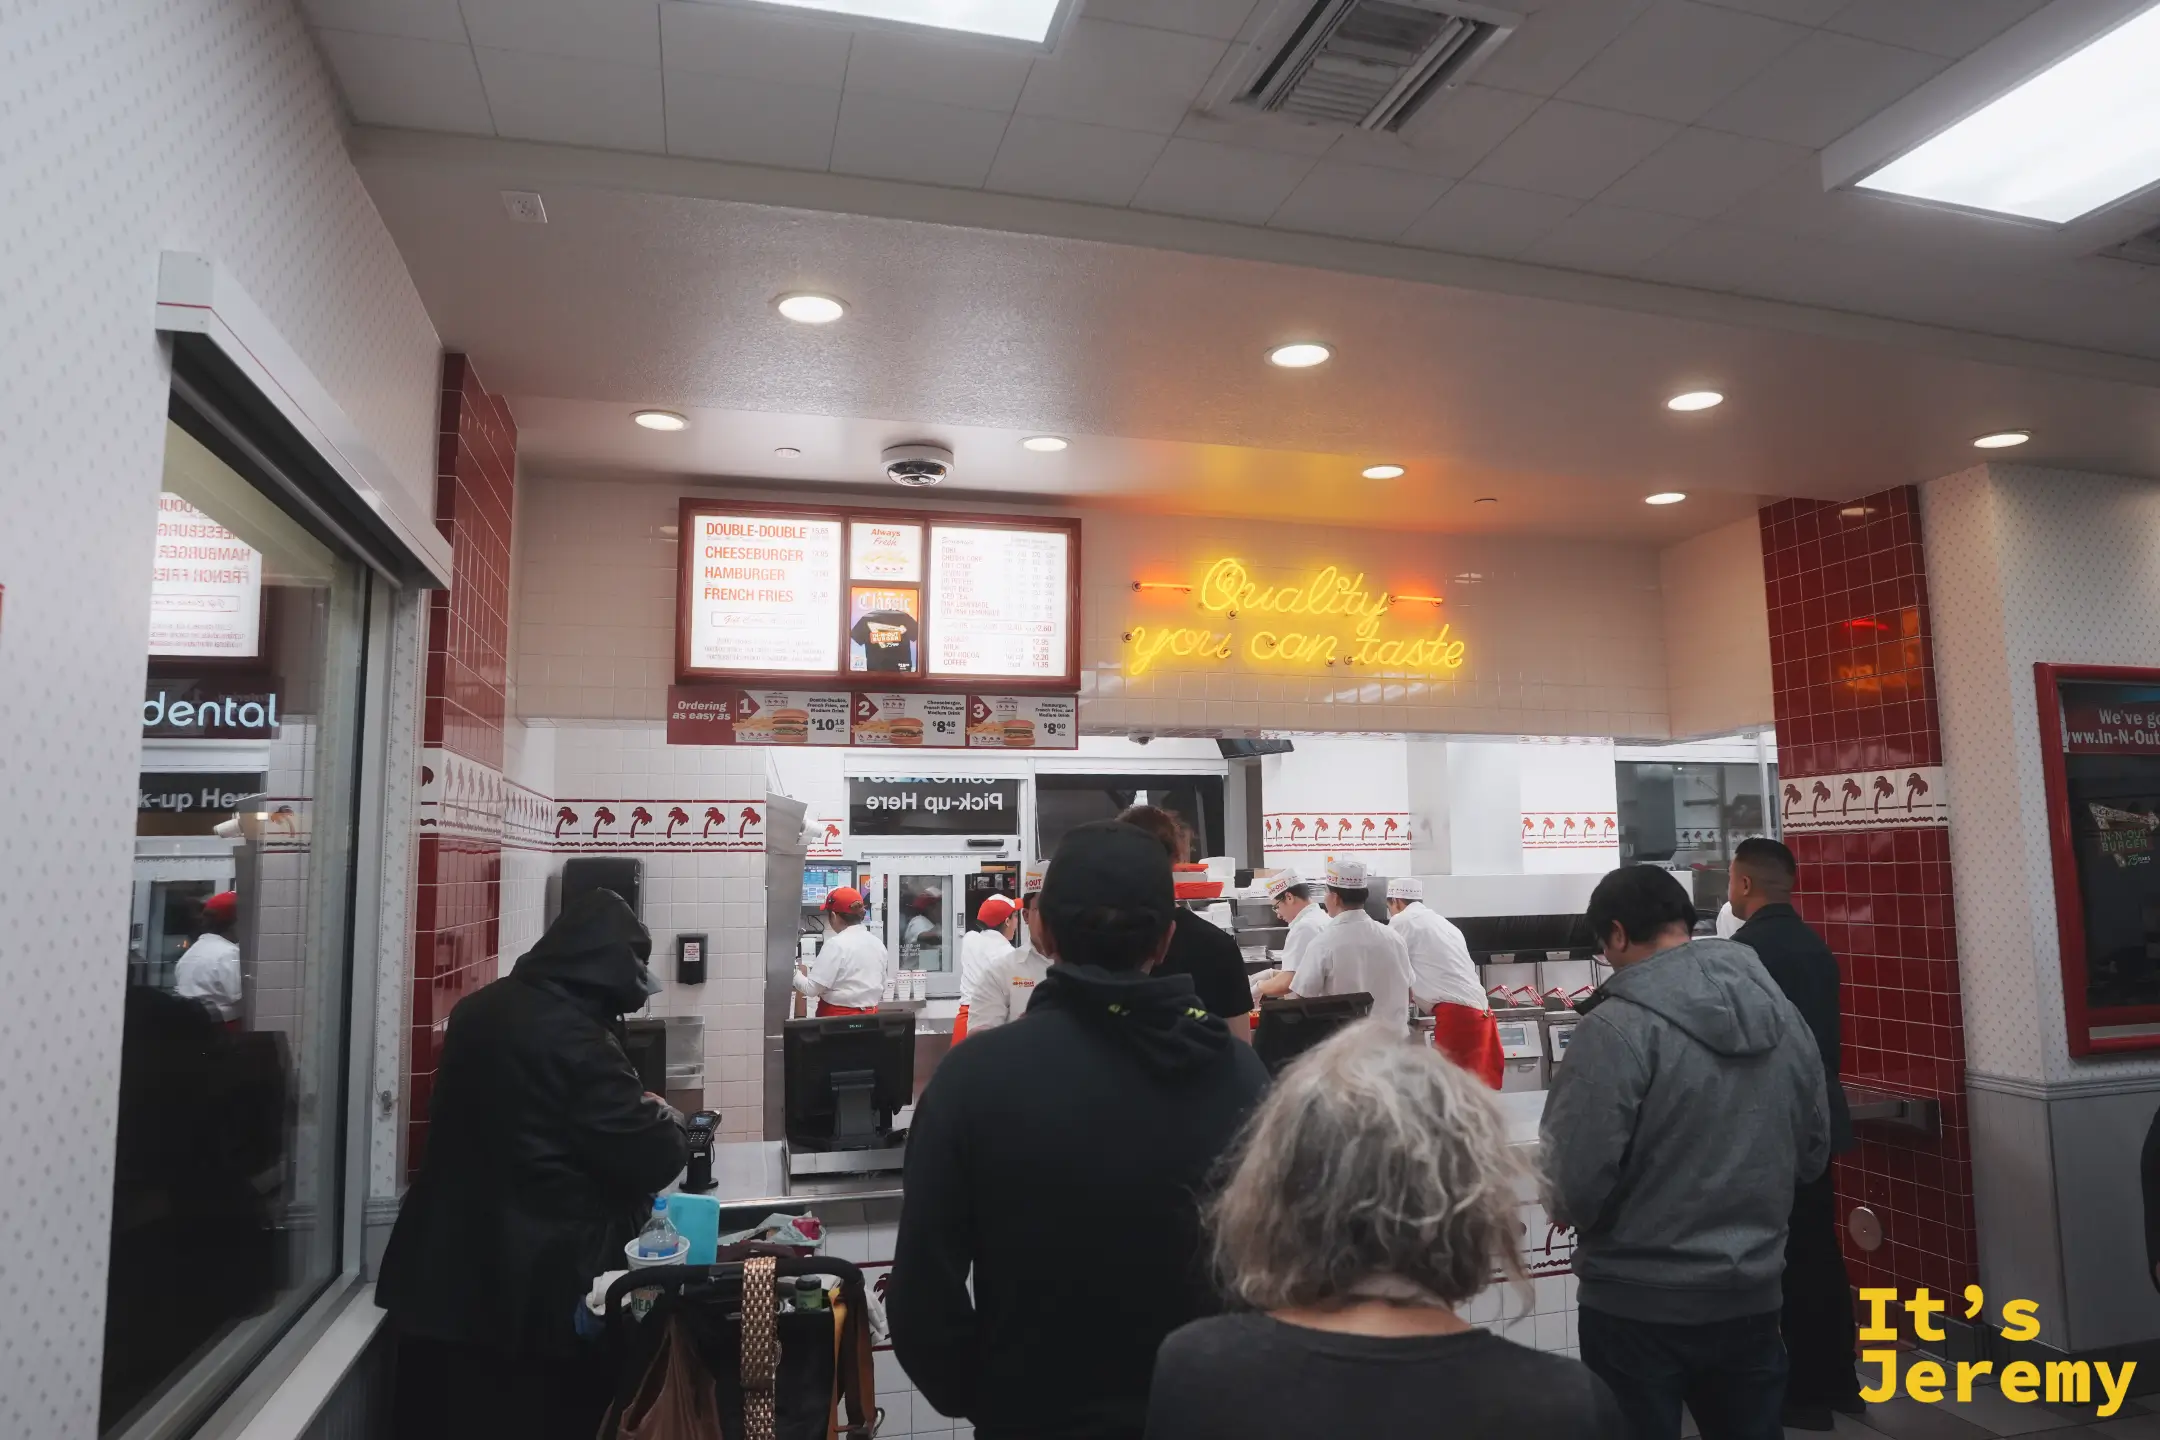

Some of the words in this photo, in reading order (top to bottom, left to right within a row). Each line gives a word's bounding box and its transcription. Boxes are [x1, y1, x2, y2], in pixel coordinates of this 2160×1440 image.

[705, 522, 807, 539] DOUBLE-DOUBLE
[871, 528, 901, 538] Always
[704, 545, 804, 562] CHEESEBURGER
[704, 566, 786, 581] HAMBURGER
[703, 587, 755, 601] FRENCH
[758, 589, 794, 603] FRIES
[858, 592, 912, 611] Classic
[1201, 557, 1388, 636] Quality
[1130, 626, 1232, 676] you
[1251, 630, 1338, 665] can
[1354, 623, 1465, 668] taste
[142, 691, 280, 728] dental
[677, 700, 728, 712] Ordering
[740, 699, 752, 714] 1
[858, 701, 870, 715] 2
[973, 703, 985, 718] 3
[672, 712, 687, 721] as
[689, 713, 715, 723] easy
[717, 713, 731, 721] as
[2098, 708, 2143, 725] We've
